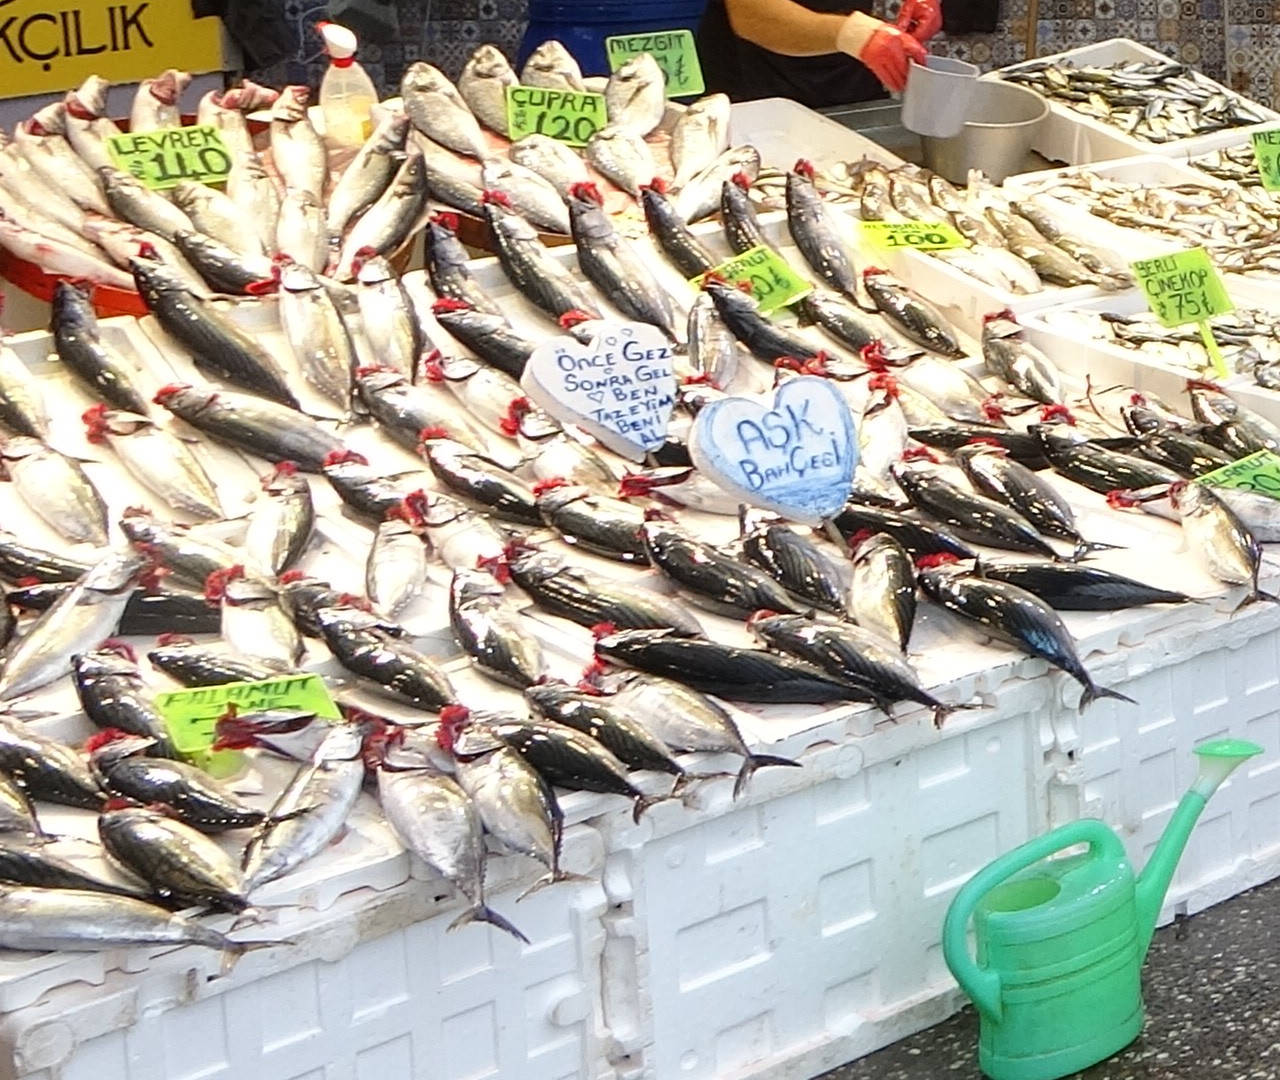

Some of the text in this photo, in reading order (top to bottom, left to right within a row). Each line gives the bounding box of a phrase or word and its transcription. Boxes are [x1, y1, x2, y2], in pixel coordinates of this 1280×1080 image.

[511, 88, 598, 114] ÇUPRA
[536, 111, 597, 142] 120
[111, 128, 223, 155] LEVREK
[886, 233, 949, 247] 100
[622, 341, 671, 362] GEZ
[564, 365, 672, 392] SONRA GEL
[612, 385, 658, 402] BEN
[639, 430, 667, 447] AL
